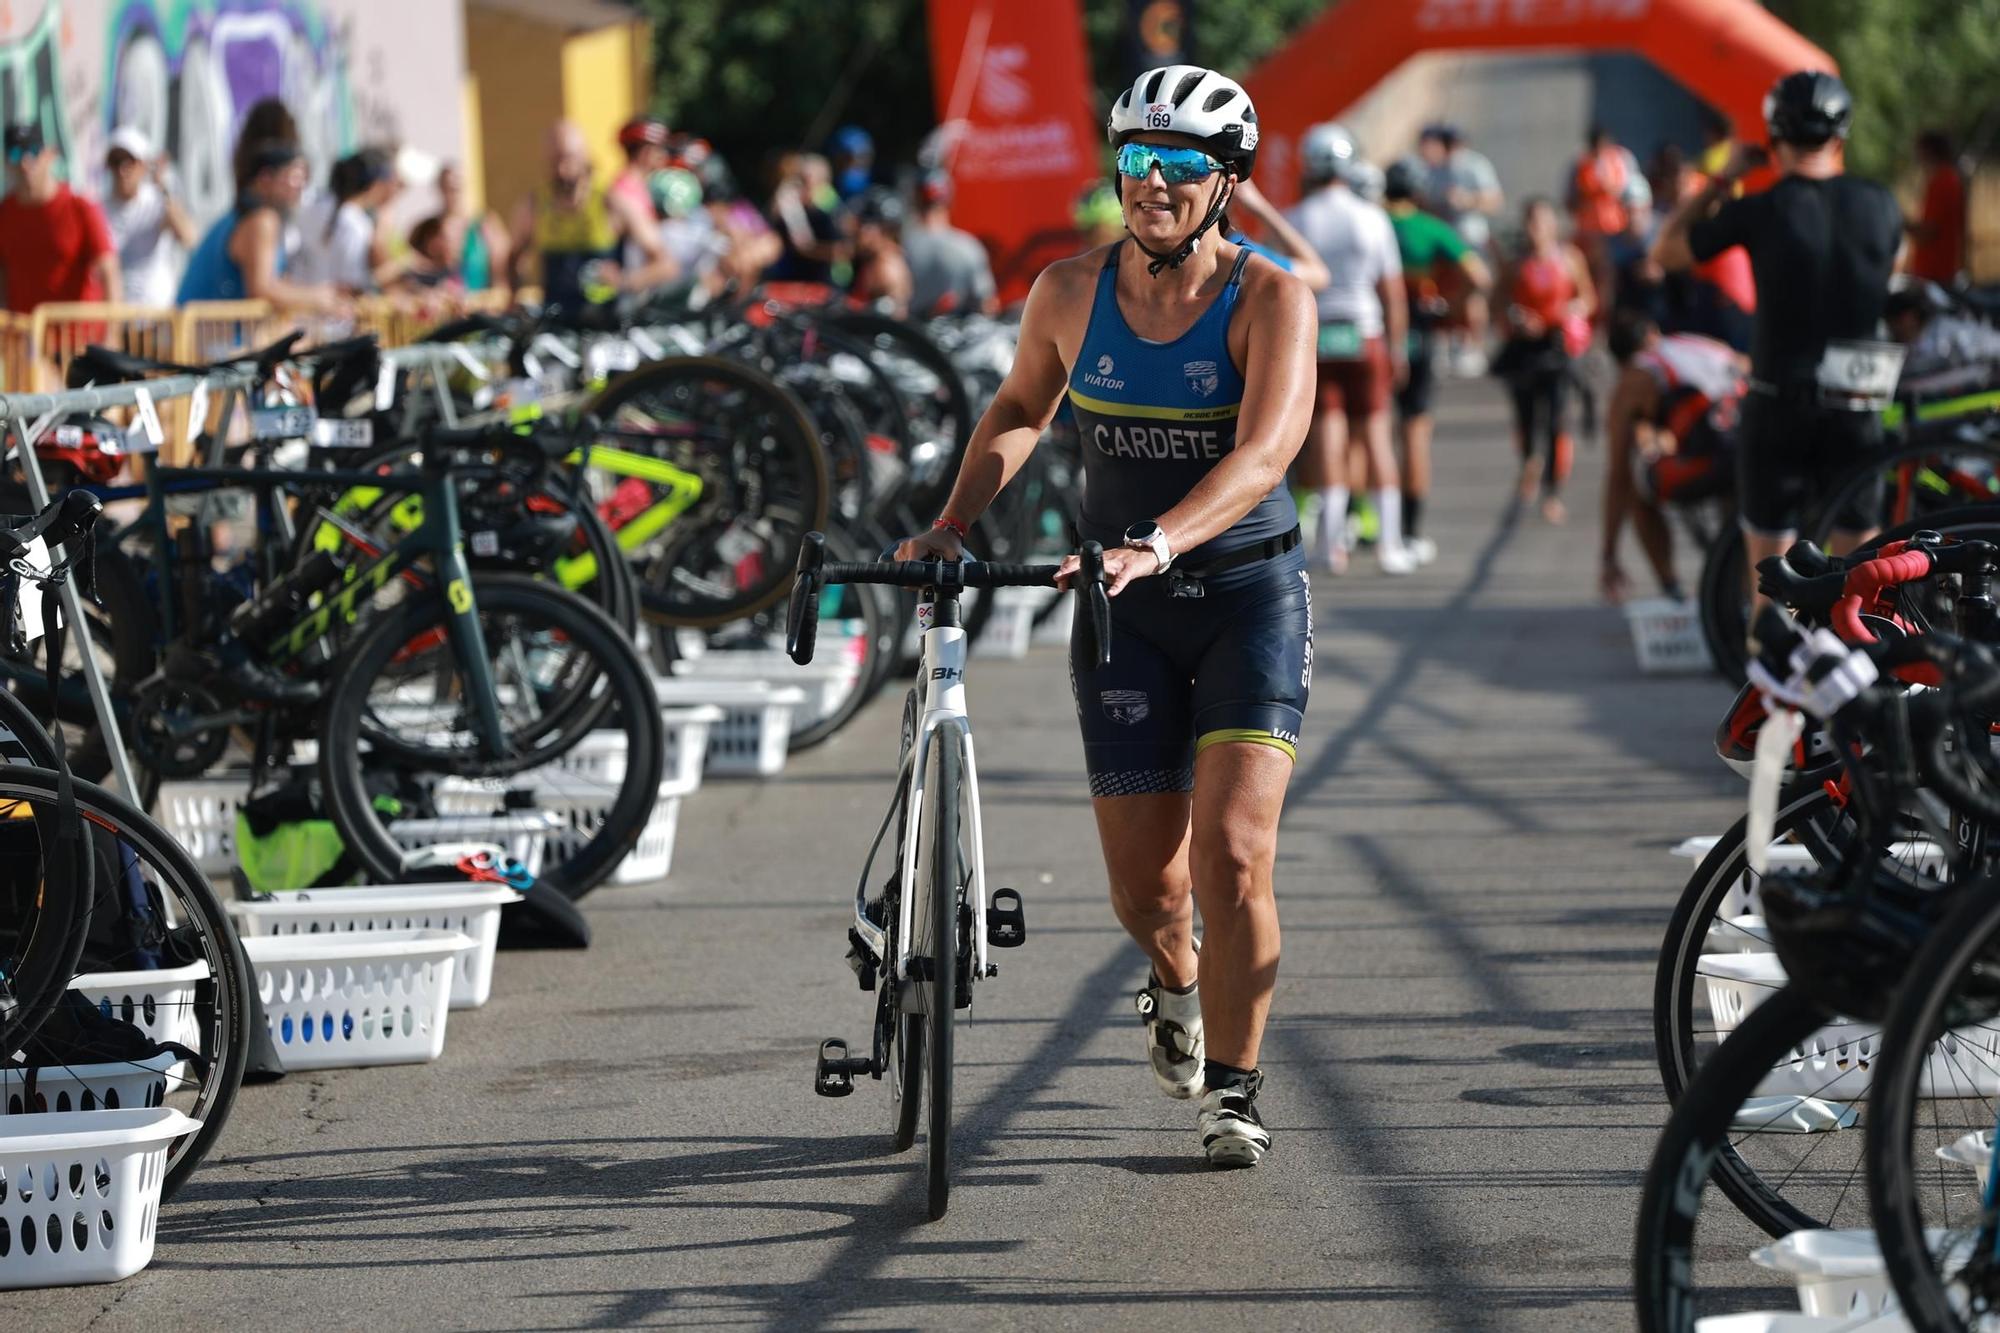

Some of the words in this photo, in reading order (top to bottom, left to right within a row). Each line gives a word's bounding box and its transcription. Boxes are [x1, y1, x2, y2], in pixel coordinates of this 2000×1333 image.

[1145, 113, 1171, 128] 169
[1084, 372, 1125, 390] VIATOR
[1094, 423, 1220, 459] CARDETE
[1301, 640, 1312, 689] CLUB
[931, 667, 963, 681] BH
